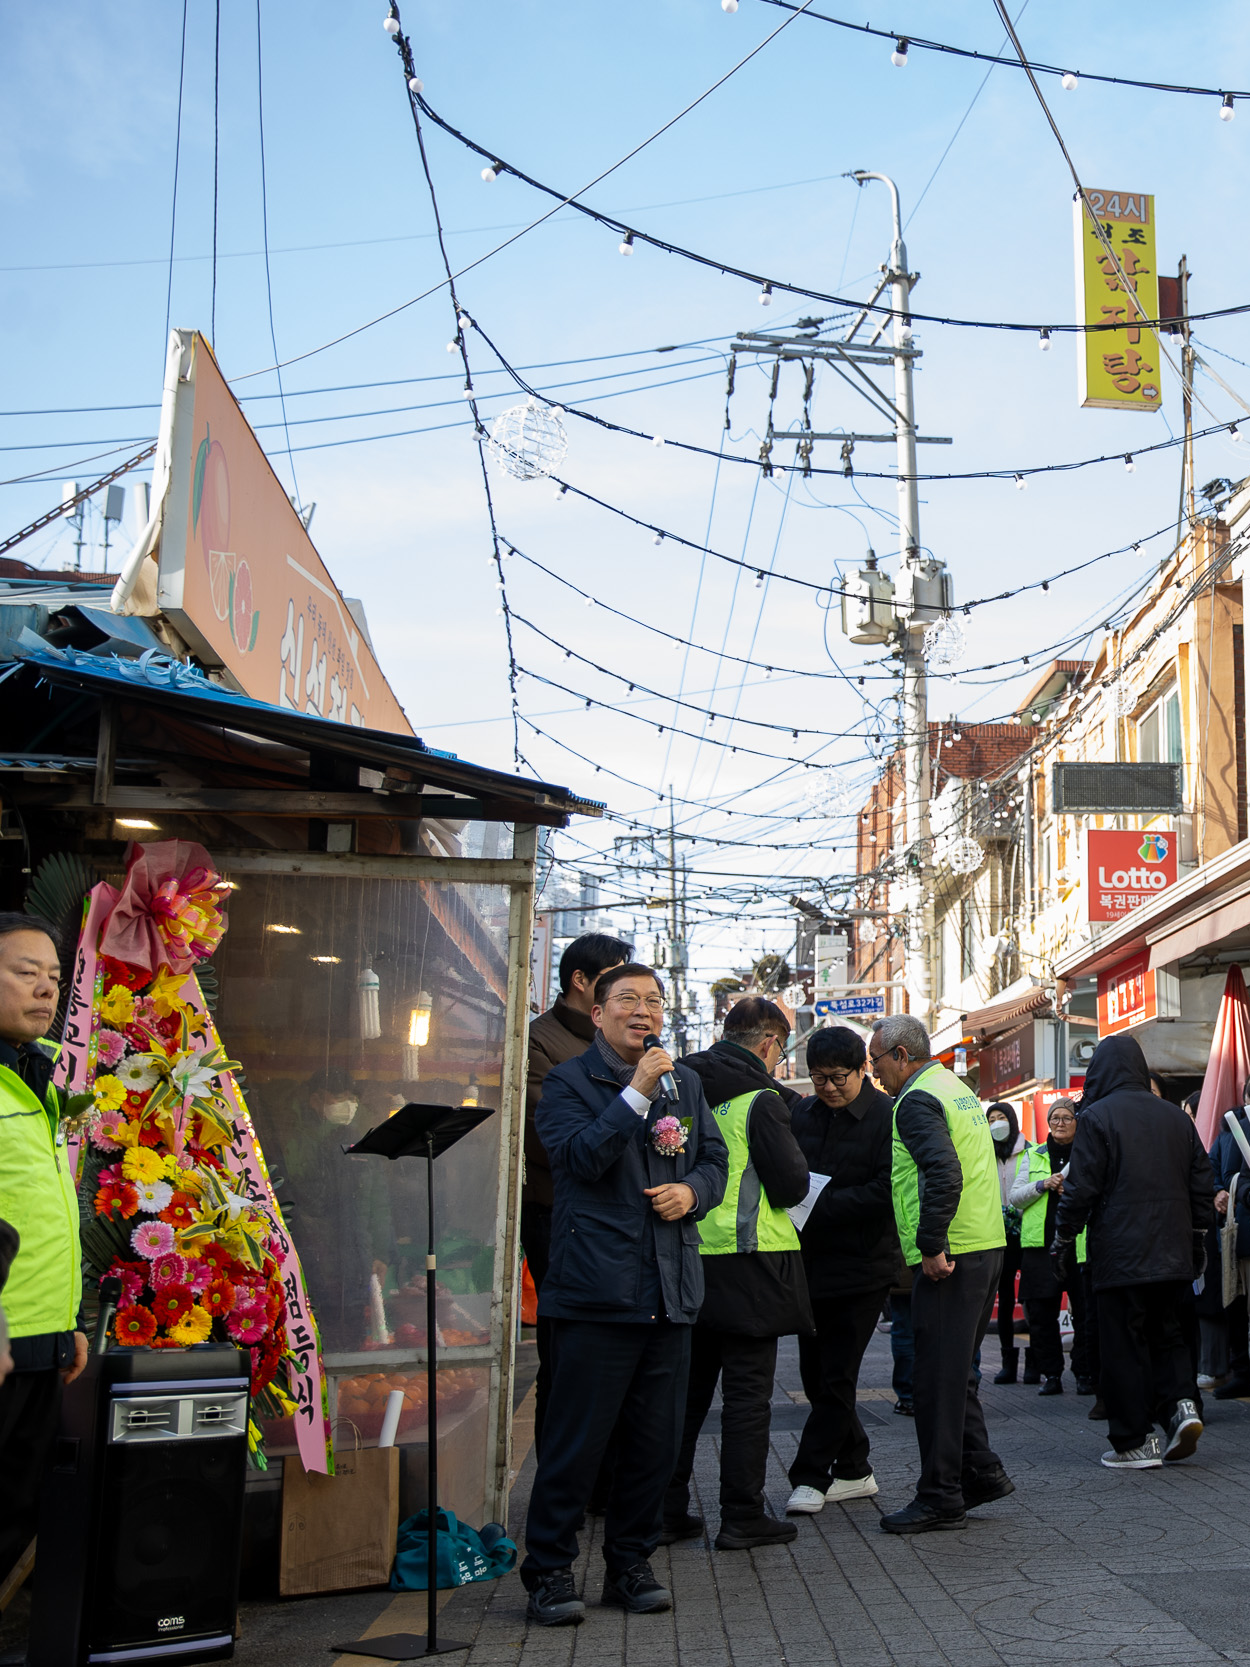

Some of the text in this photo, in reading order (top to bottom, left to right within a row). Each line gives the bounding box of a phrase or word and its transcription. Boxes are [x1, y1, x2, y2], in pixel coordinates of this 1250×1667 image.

[1089, 192, 1148, 223] 24시
[1095, 248, 1154, 395] 감자탕
[1099, 866, 1167, 889] Lotto
[283, 1271, 315, 1426] 점등식
[1181, 1401, 1196, 1415] 13
[157, 1615, 185, 1627] coms
